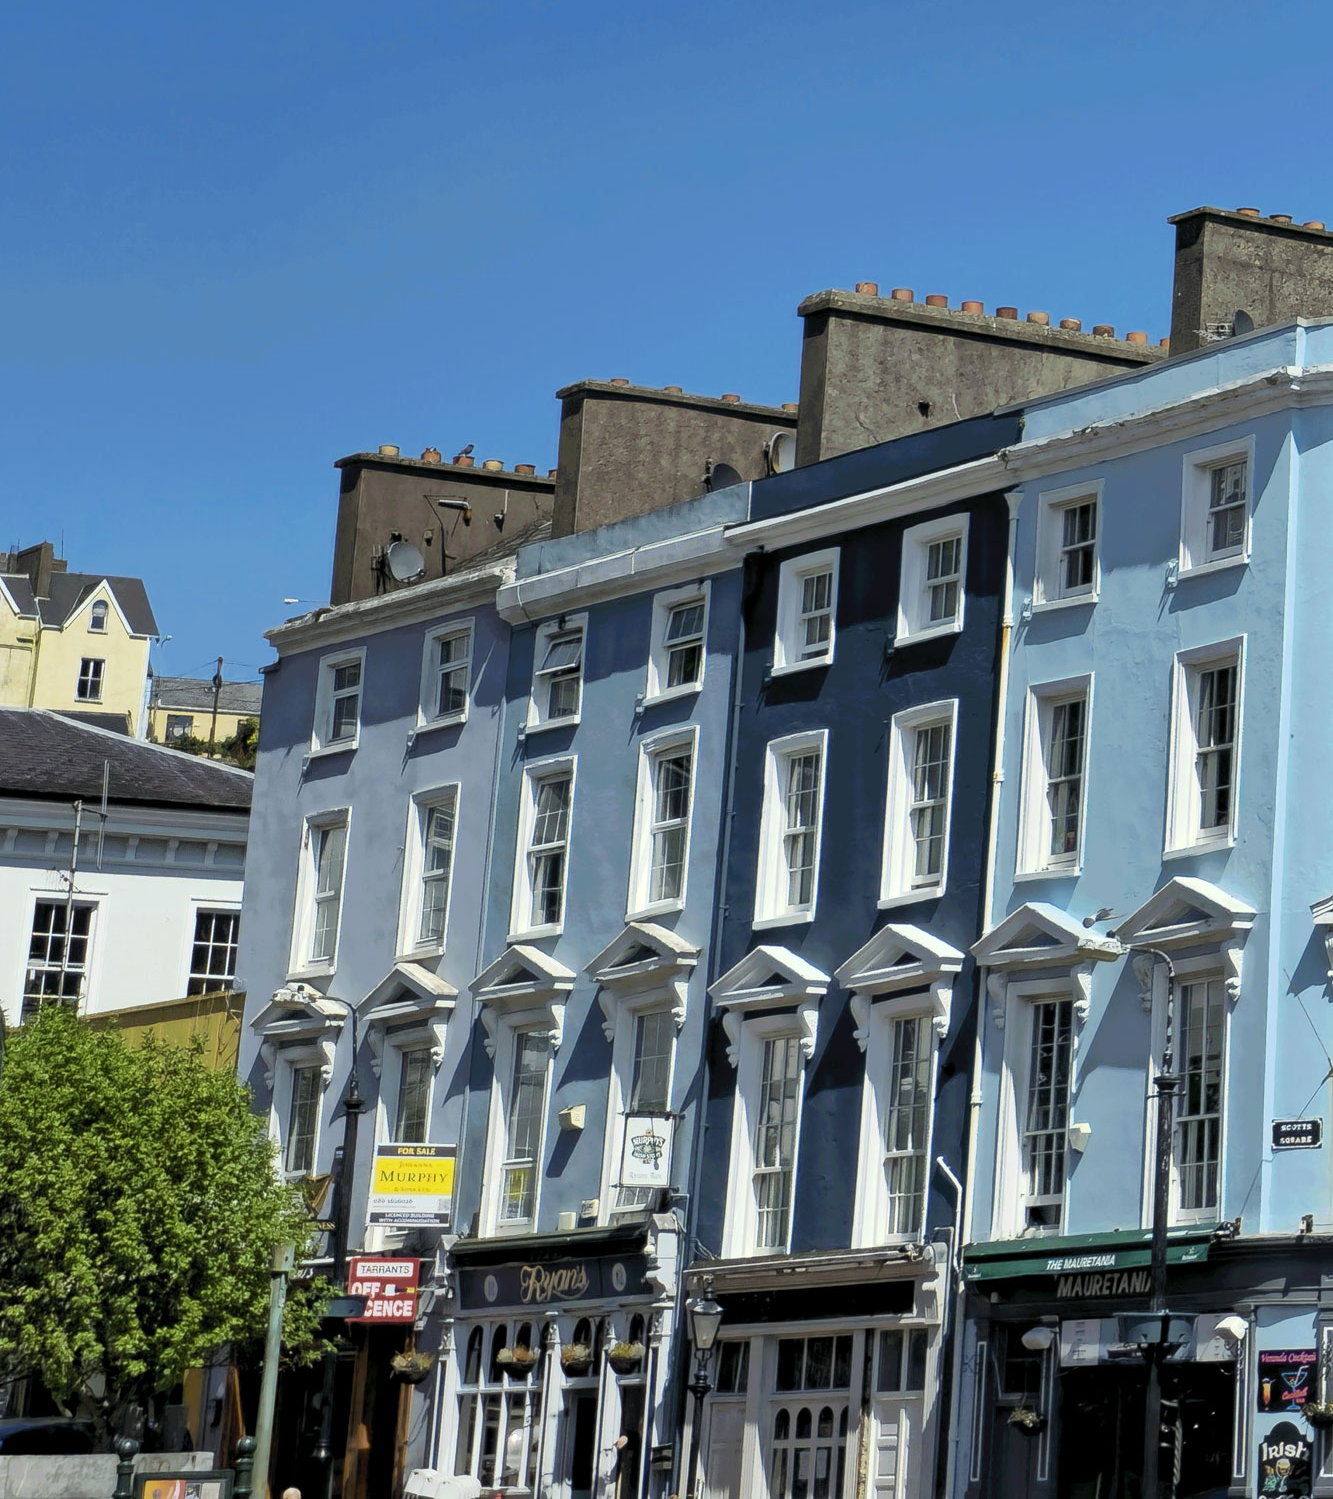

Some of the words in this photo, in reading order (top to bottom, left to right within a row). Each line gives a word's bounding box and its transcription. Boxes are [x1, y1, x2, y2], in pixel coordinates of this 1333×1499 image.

[1281, 1123, 1312, 1131] SCOTTS
[1280, 1136, 1312, 1144] SQUARE
[397, 1147, 415, 1155] FOR
[416, 1148, 436, 1156] SALE
[380, 1170, 448, 1183] MURPHY
[1047, 1260, 1062, 1270] THE
[1063, 1254, 1116, 1268] MAURETANIA
[361, 1265, 410, 1274] TARRANTS
[351, 1282, 381, 1298] OFF
[364, 1300, 413, 1317] CENCE
